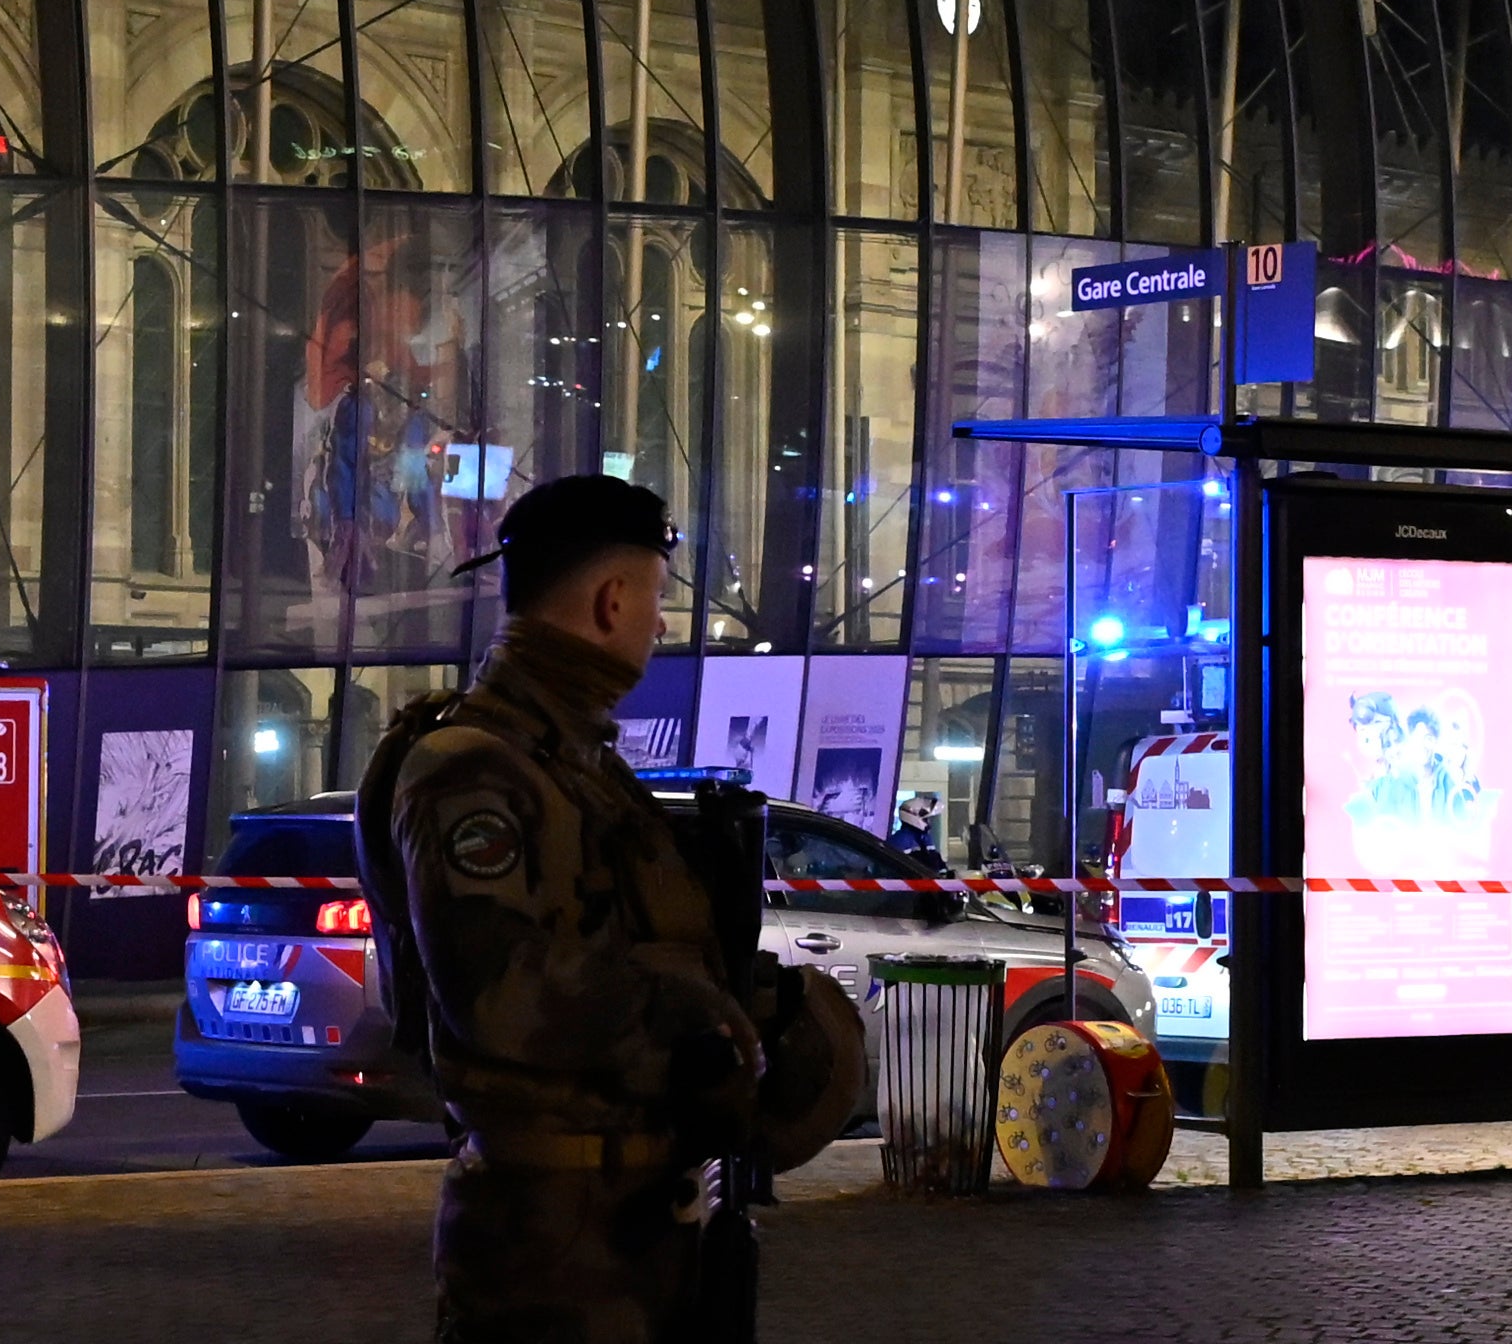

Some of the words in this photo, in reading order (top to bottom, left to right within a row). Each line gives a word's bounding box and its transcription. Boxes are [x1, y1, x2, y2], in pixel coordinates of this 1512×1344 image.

[1251, 246, 1278, 281] 10
[1077, 278, 1122, 301] Gare
[1126, 264, 1206, 295] Centrale
[1395, 525, 1447, 539] JCDecaux
[1326, 601, 1467, 629] CONFÉRENCE
[1326, 631, 1487, 656] D'ORIENTATION
[1173, 911, 1193, 929] 17
[201, 943, 269, 964] POLICE
